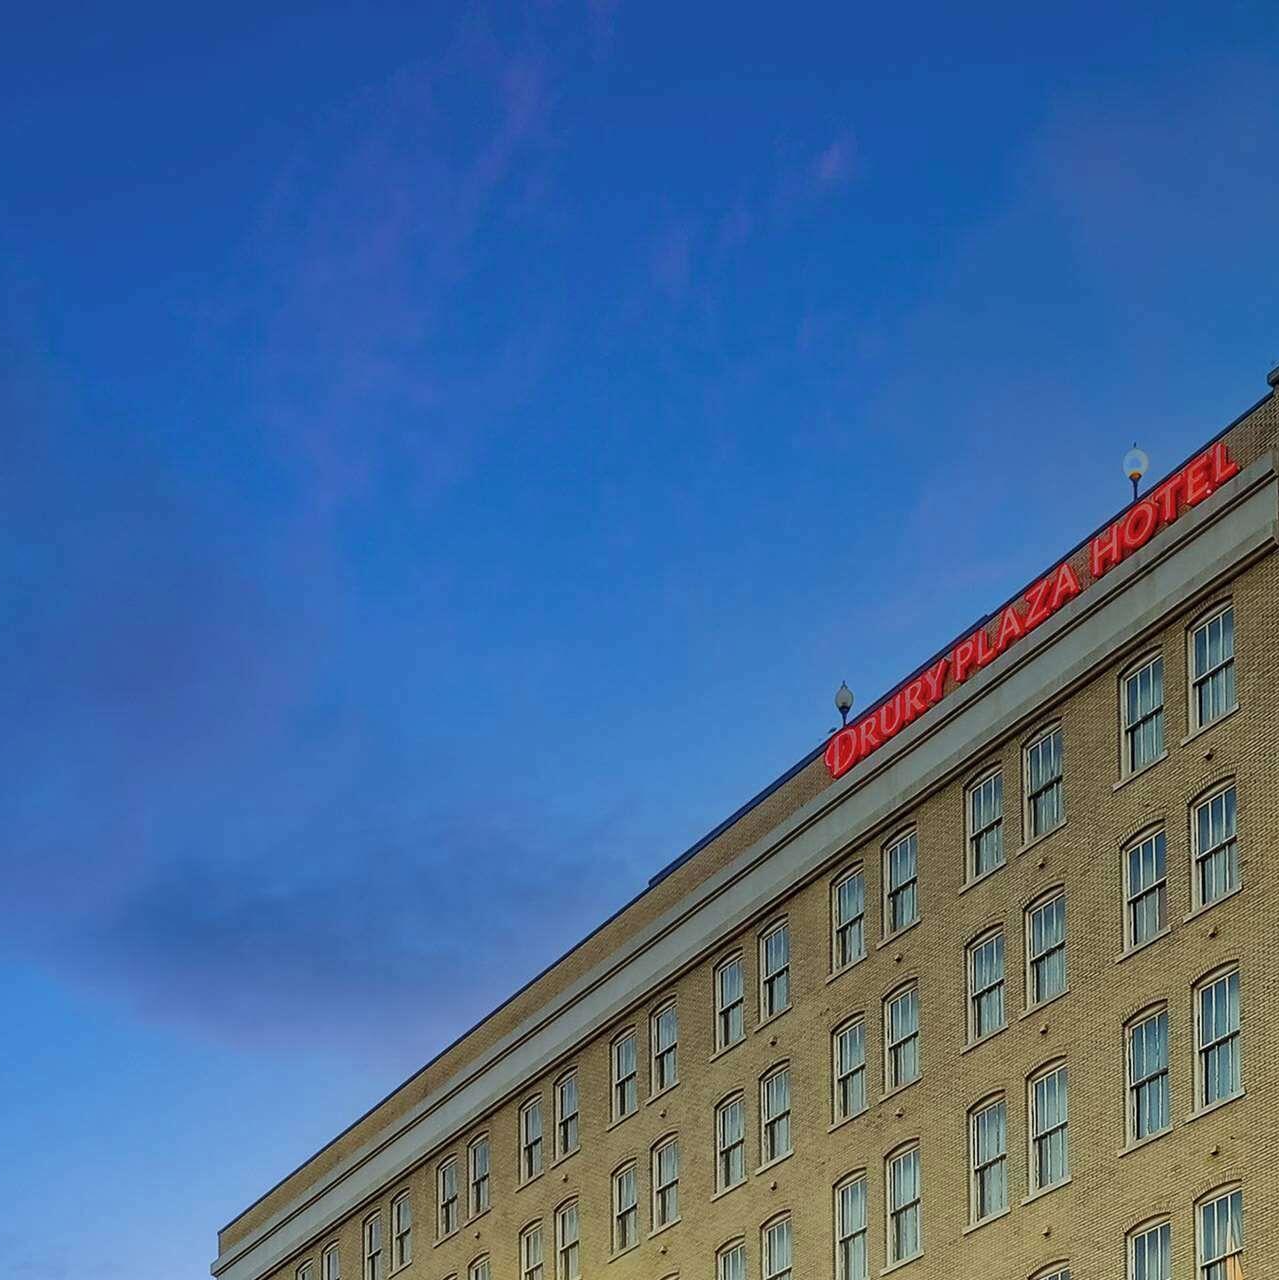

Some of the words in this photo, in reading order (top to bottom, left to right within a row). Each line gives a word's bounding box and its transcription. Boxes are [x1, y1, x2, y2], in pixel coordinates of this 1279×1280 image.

[824, 657, 951, 780] DRURY
[951, 562, 1082, 683] PLAZA
[1089, 441, 1240, 578] HOTEL
